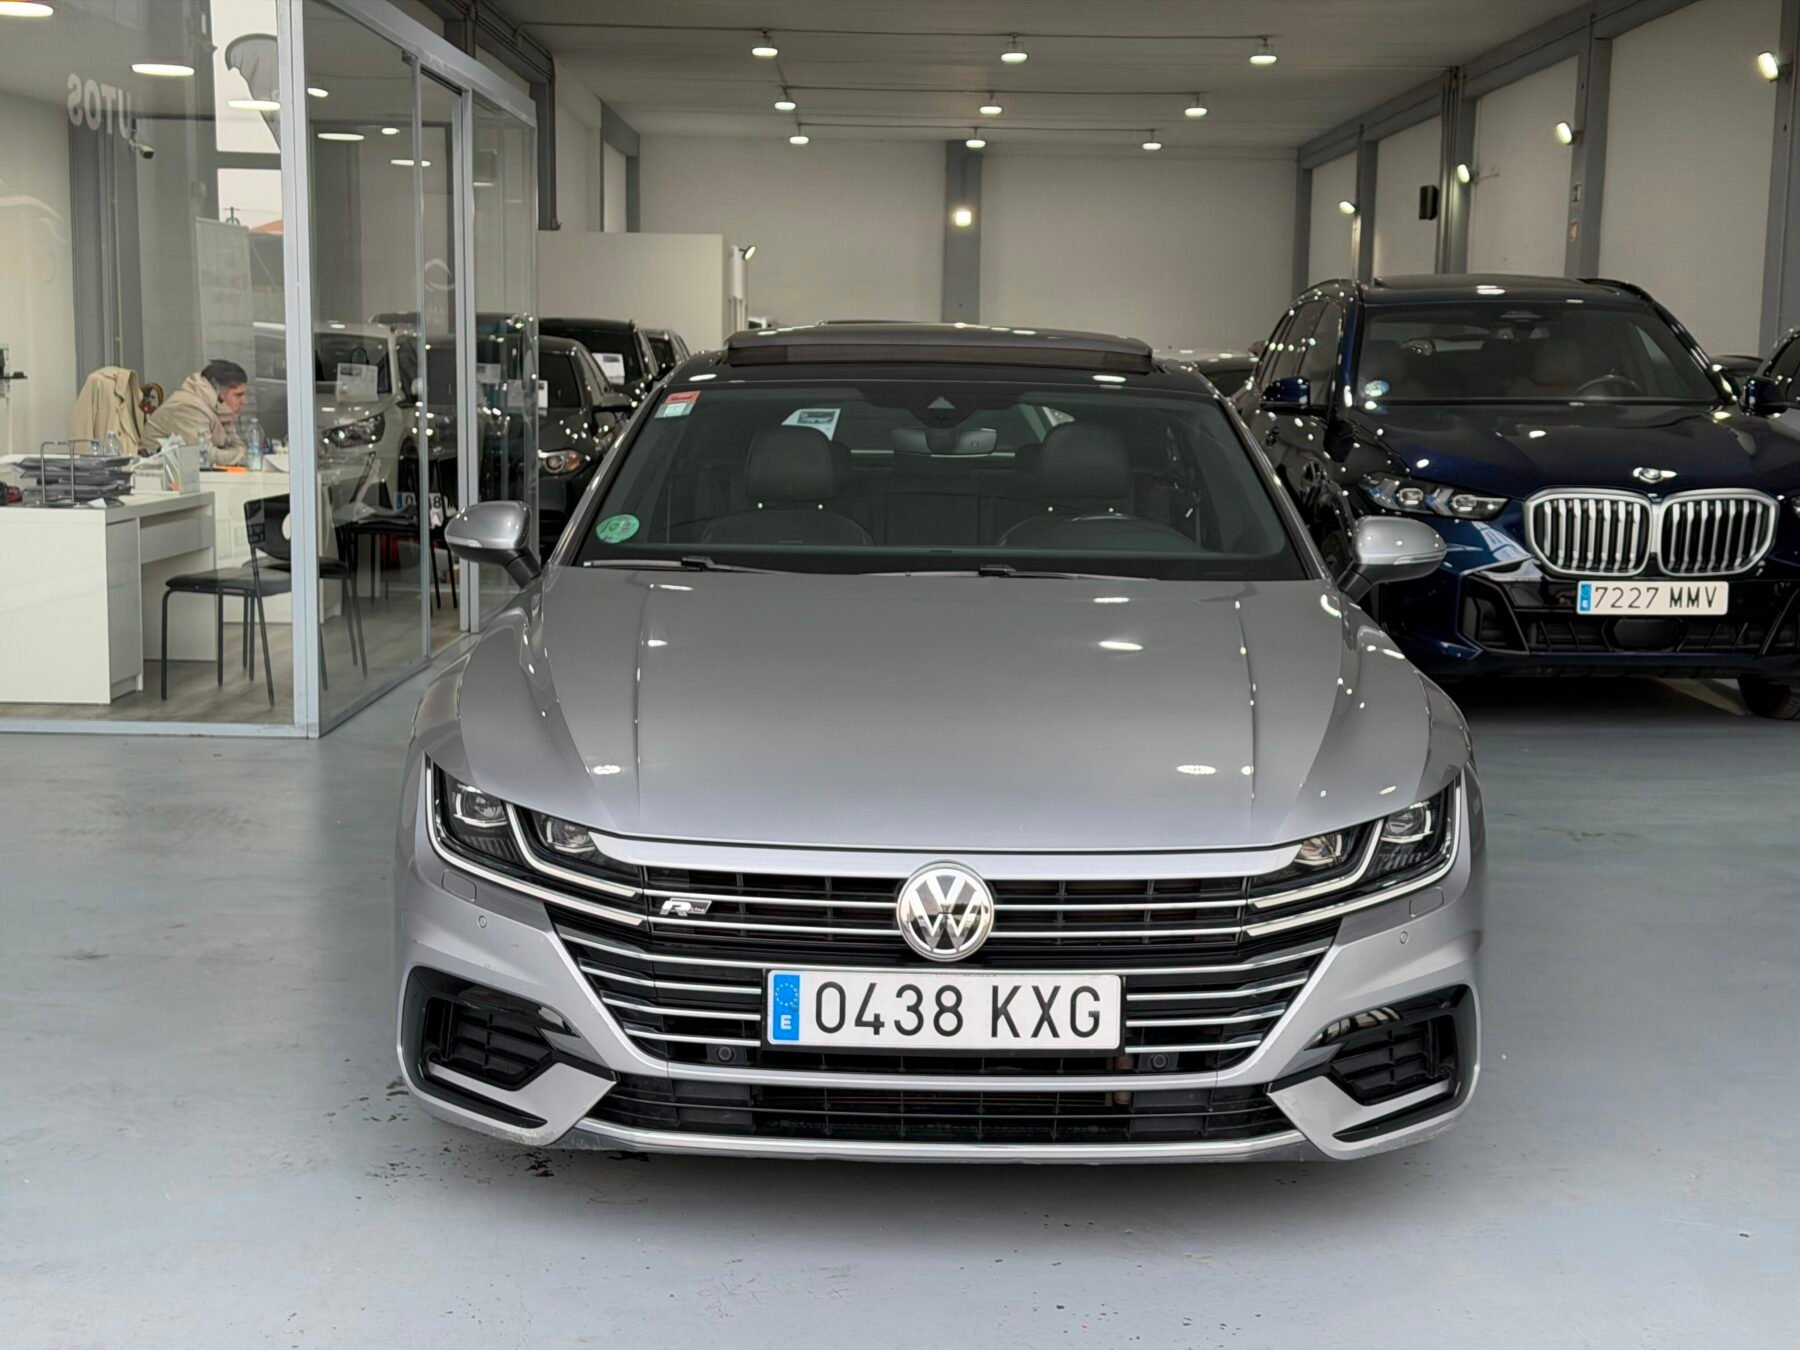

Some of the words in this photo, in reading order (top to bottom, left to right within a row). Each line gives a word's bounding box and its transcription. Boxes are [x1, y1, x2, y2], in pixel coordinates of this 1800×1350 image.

[1594, 586, 1660, 609] 7227
[1669, 586, 1718, 609] MMV
[815, 981, 963, 1037] 0438
[991, 985, 1101, 1038] KXG
[780, 1014, 792, 1030] E
